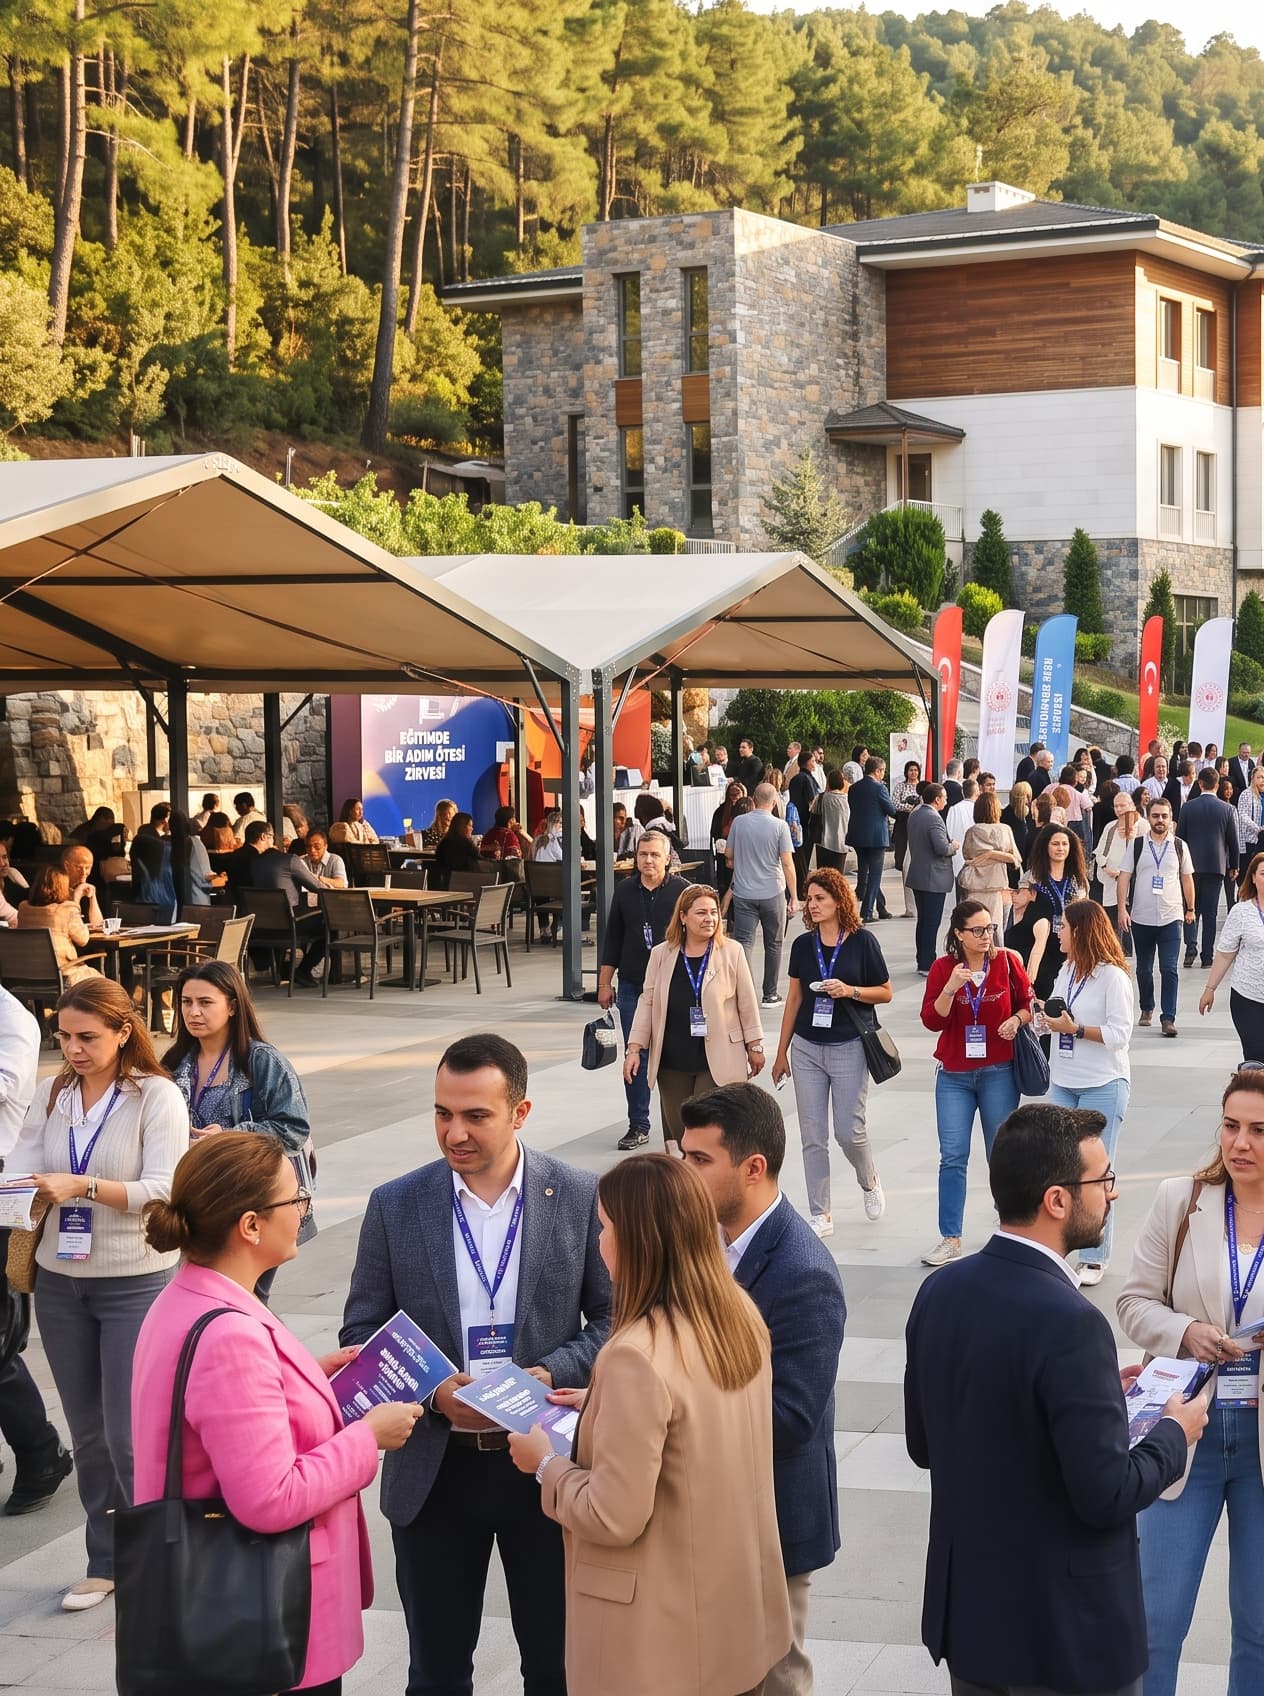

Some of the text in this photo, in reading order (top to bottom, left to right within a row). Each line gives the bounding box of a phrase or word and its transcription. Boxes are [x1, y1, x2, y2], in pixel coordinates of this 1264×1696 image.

[384, 746, 404, 764] BİR
[406, 749, 434, 763] ADIM
[404, 763, 446, 781] ZİRVESİ
